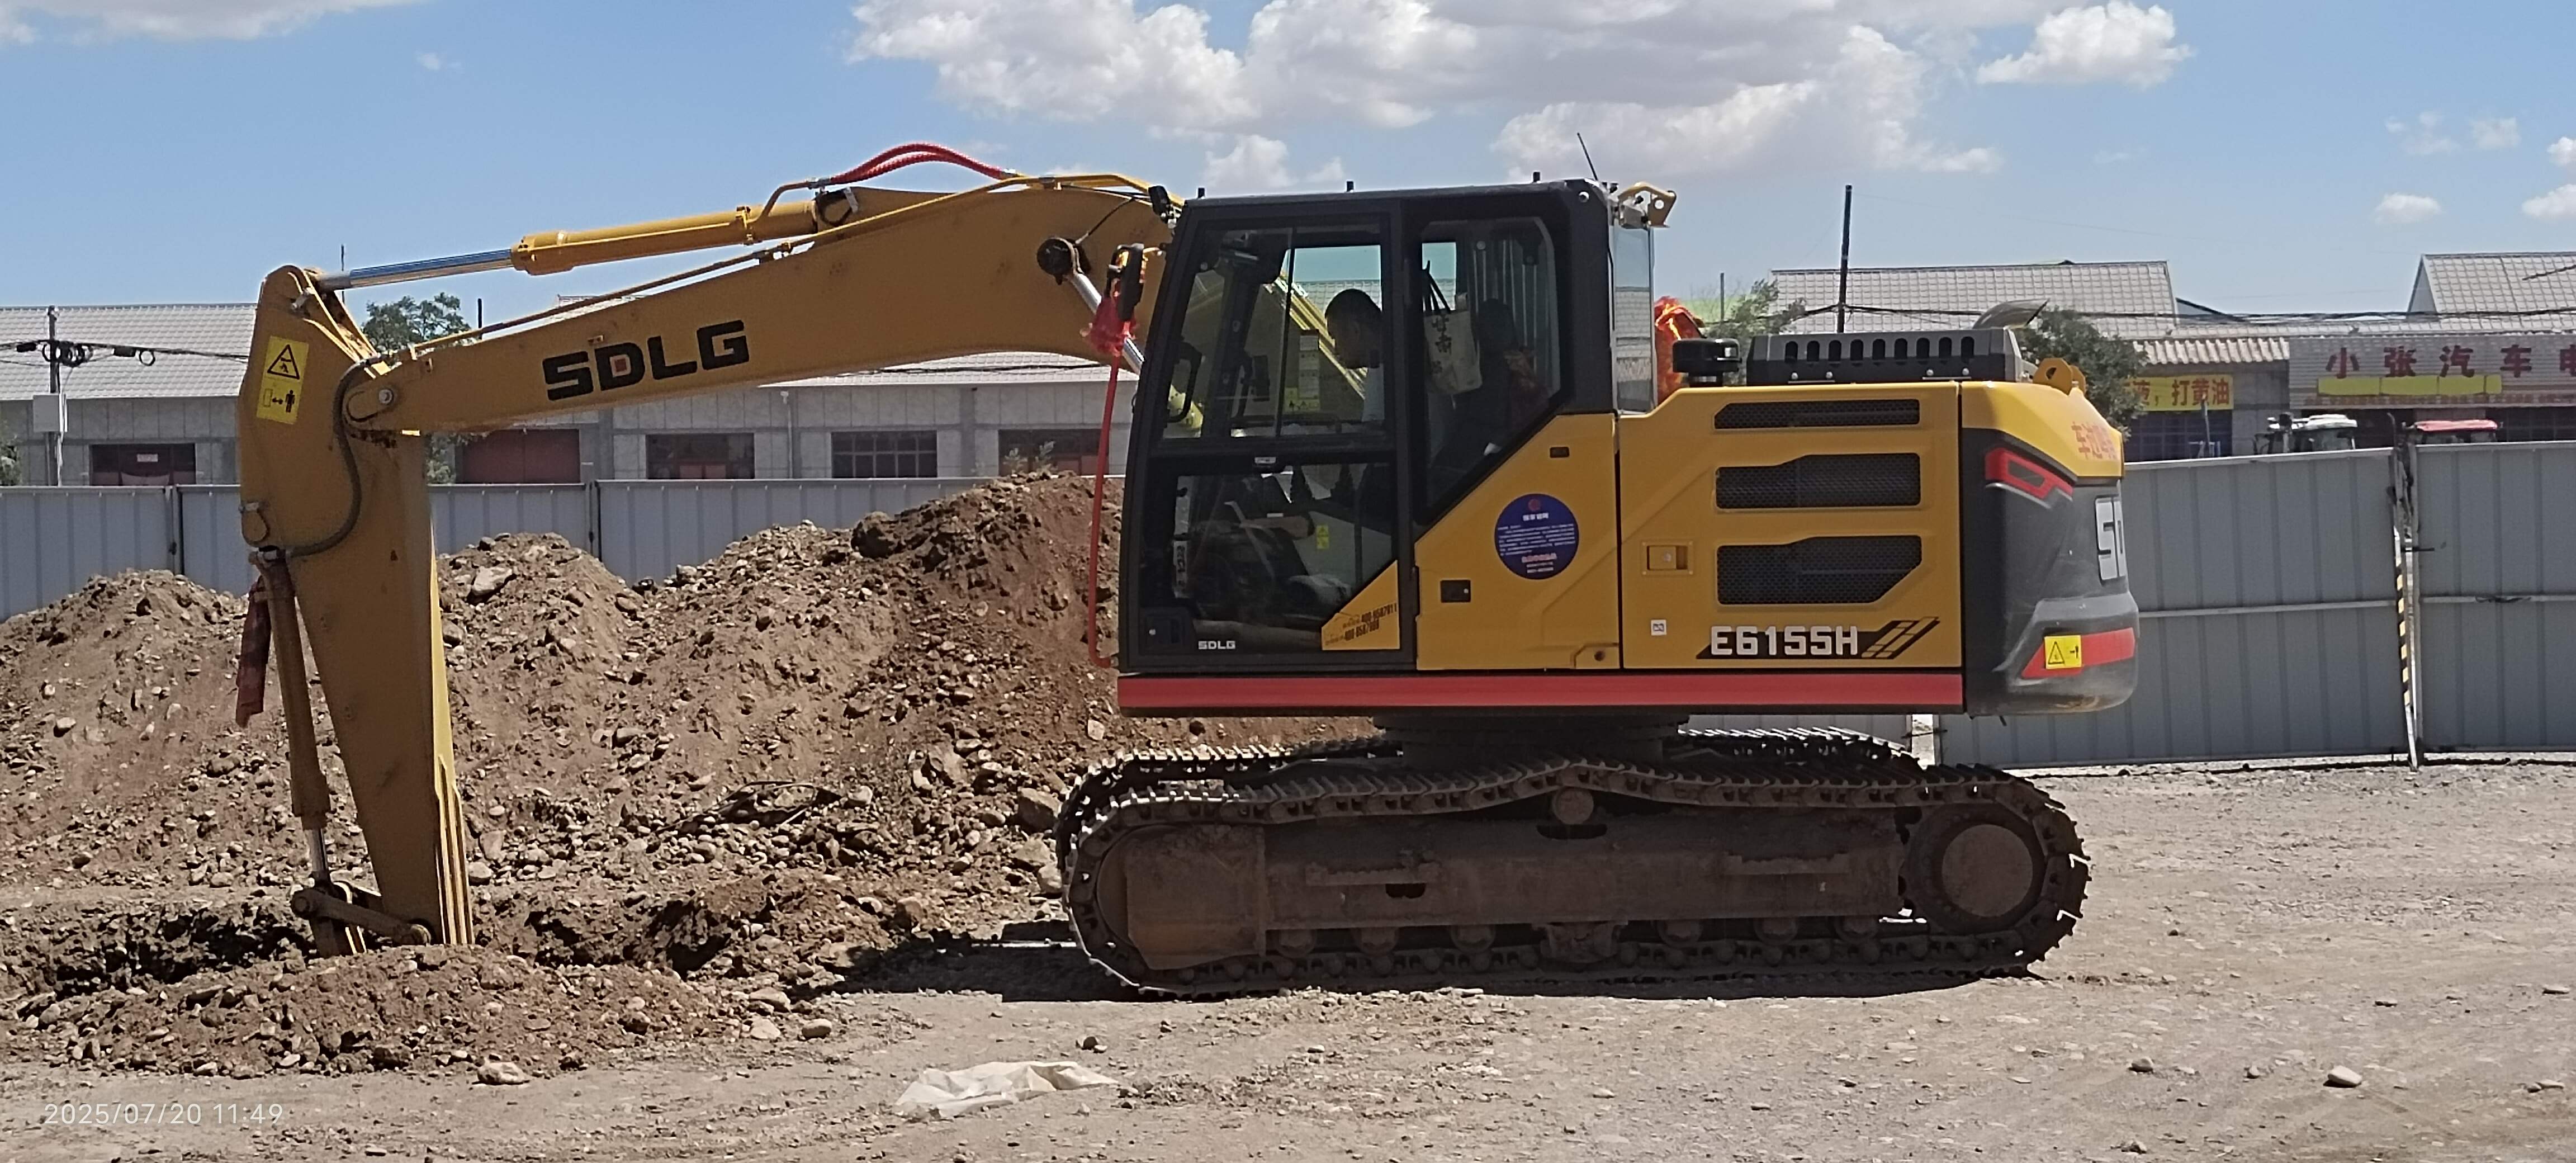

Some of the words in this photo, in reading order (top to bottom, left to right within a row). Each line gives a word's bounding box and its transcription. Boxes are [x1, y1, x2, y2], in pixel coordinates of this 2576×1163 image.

[542, 319, 750, 400] SDLG
[1198, 641, 1236, 650] SDLG
[1711, 626, 1858, 655] E6155H
